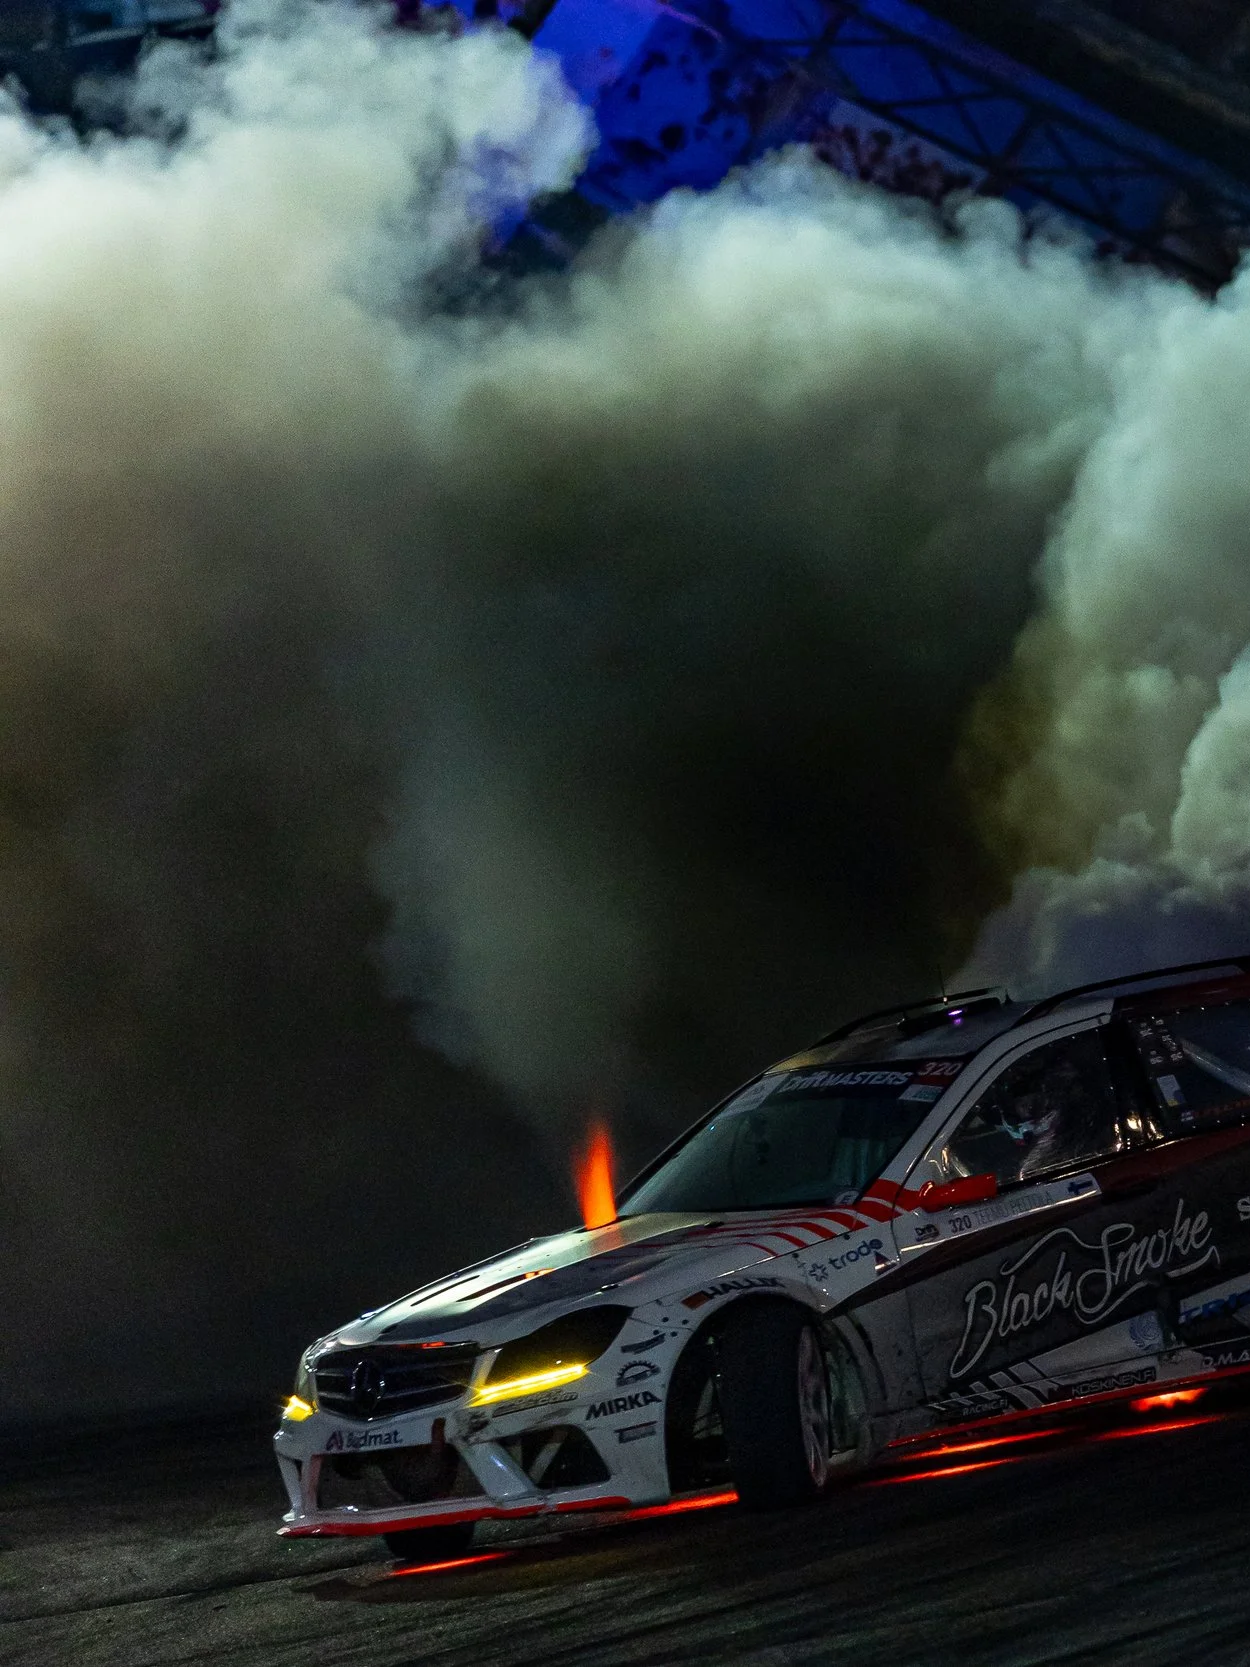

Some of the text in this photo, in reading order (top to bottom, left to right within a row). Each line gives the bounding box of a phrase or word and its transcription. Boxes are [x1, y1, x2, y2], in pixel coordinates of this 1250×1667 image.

[917, 1061, 963, 1077] 320
[949, 1214, 972, 1234] 320
[950, 1251, 1074, 1379] Black
[1073, 1198, 1220, 1325] Smoke
[585, 1390, 662, 1421] MIRKA
